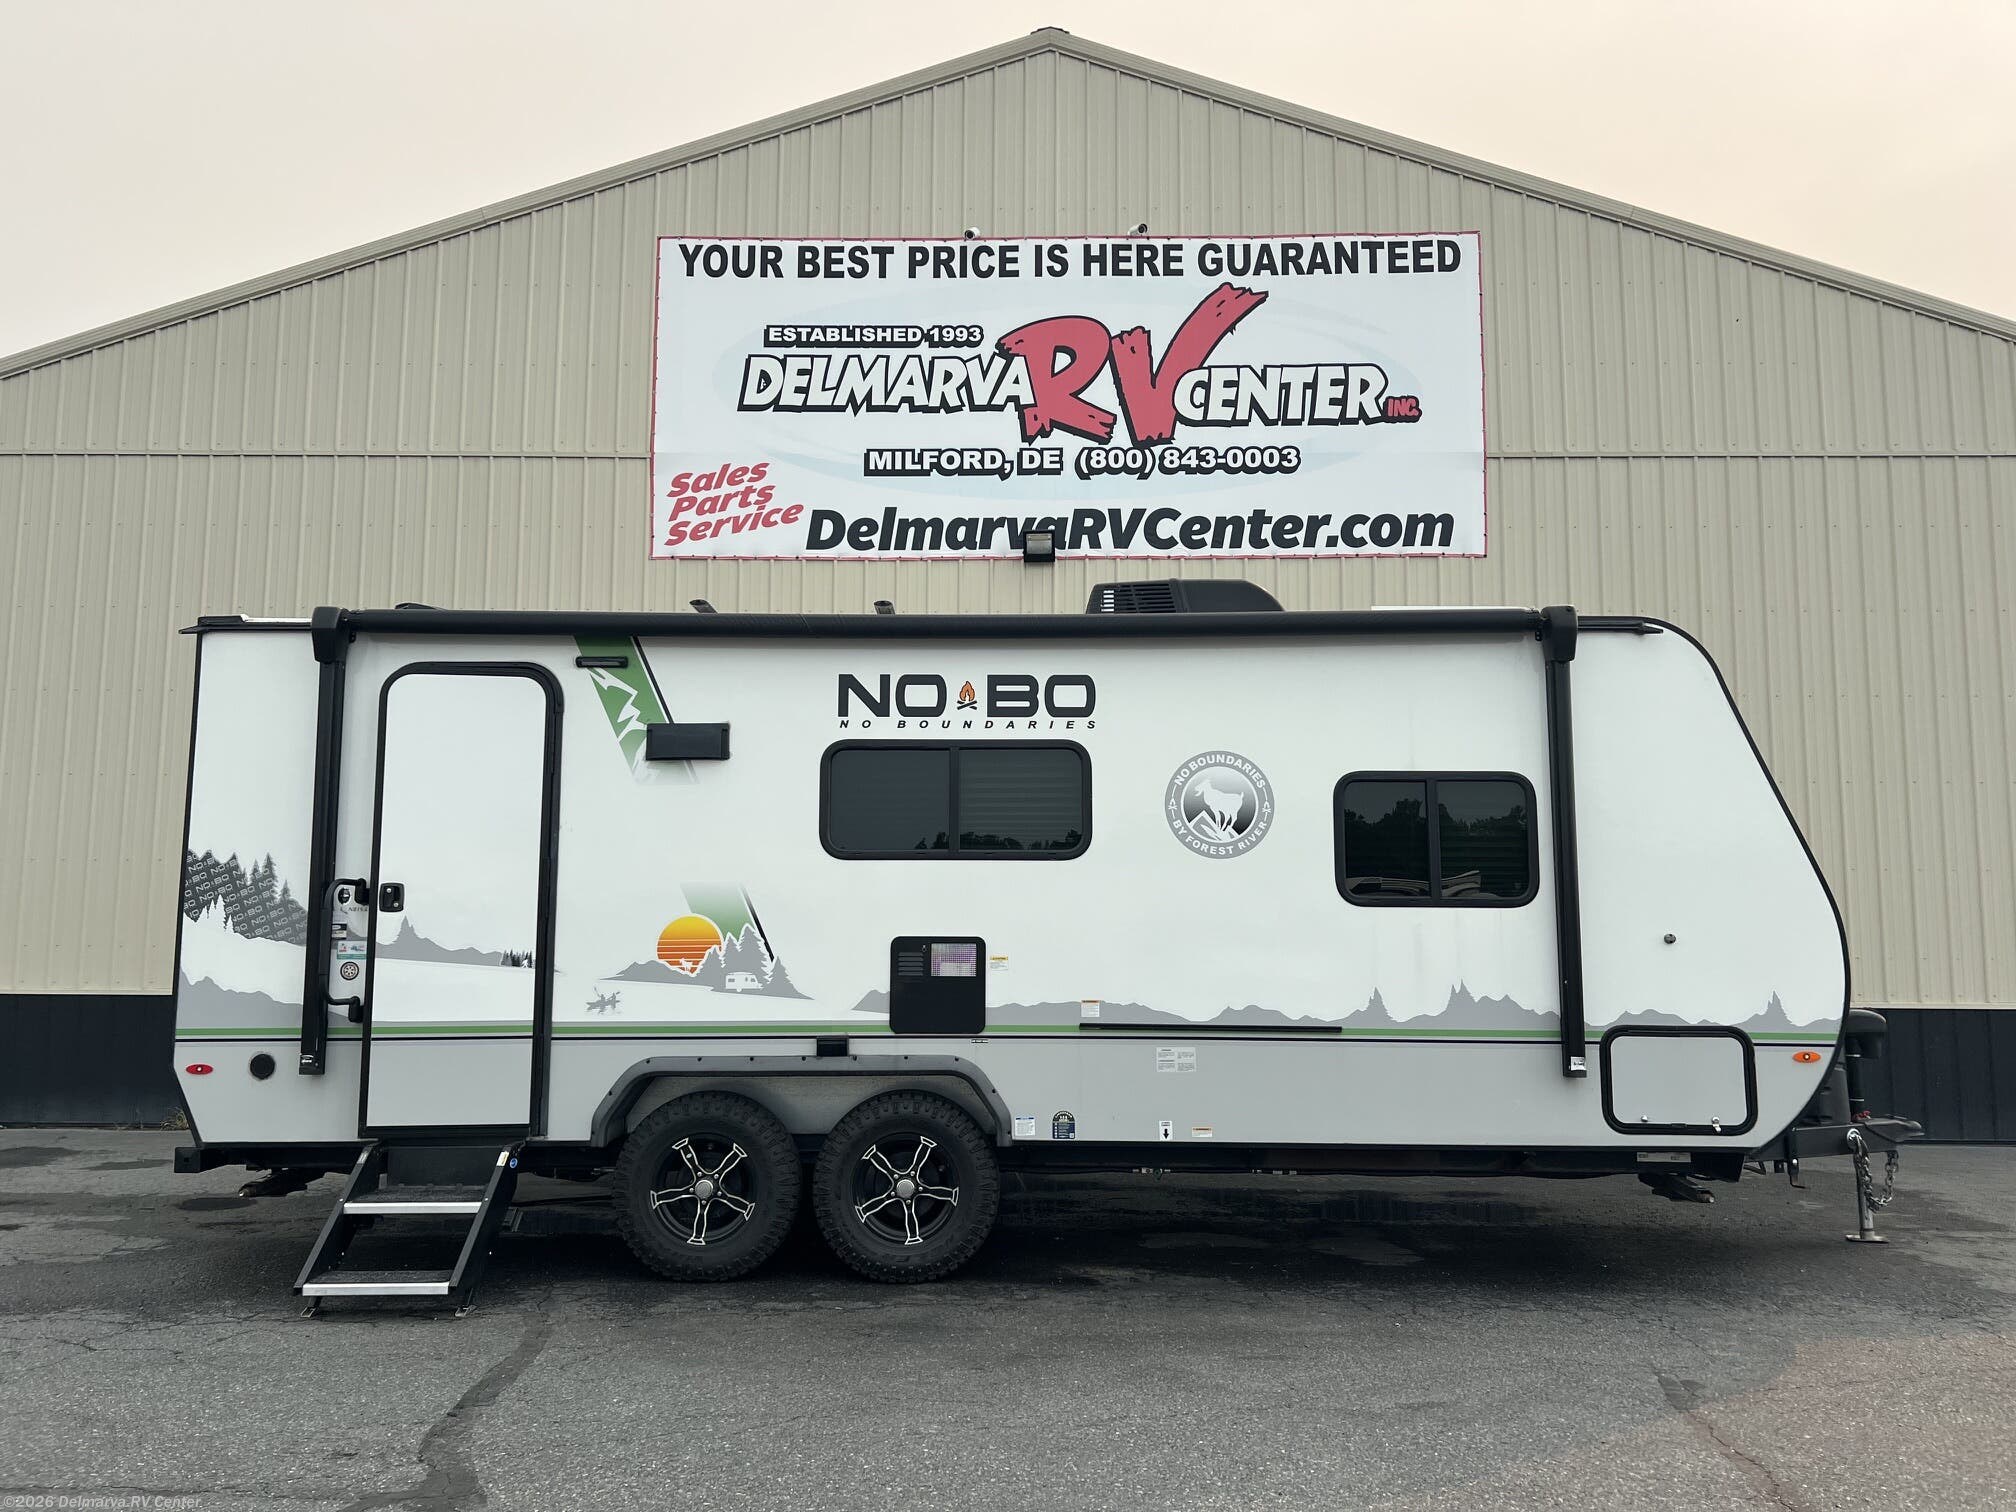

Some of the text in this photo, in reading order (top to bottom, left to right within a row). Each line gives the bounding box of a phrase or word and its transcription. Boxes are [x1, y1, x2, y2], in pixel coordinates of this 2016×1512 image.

[679, 240, 1461, 279] YOUR BEST PRICE IS HERE GUARANTEED
[767, 326, 983, 344] ESTABLISHED 1993
[738, 354, 1037, 415] DELMARVA
[997, 282, 1269, 448] RV
[1174, 364, 1389, 426] CENTER
[666, 462, 770, 497] Sales
[867, 447, 1299, 479] MILFORD, DE (800) 843-0003
[668, 484, 775, 521] Parts
[664, 503, 804, 546] Service
[805, 507, 1455, 551] DelmarvaRVCenter.com
[838, 674, 1096, 717] NO BO
[839, 720, 1096, 729] NO BOUNDARIES
[1174, 754, 1266, 788] NO BOUNDARIES
[1172, 819, 1267, 855] BY FOREST RIVER
